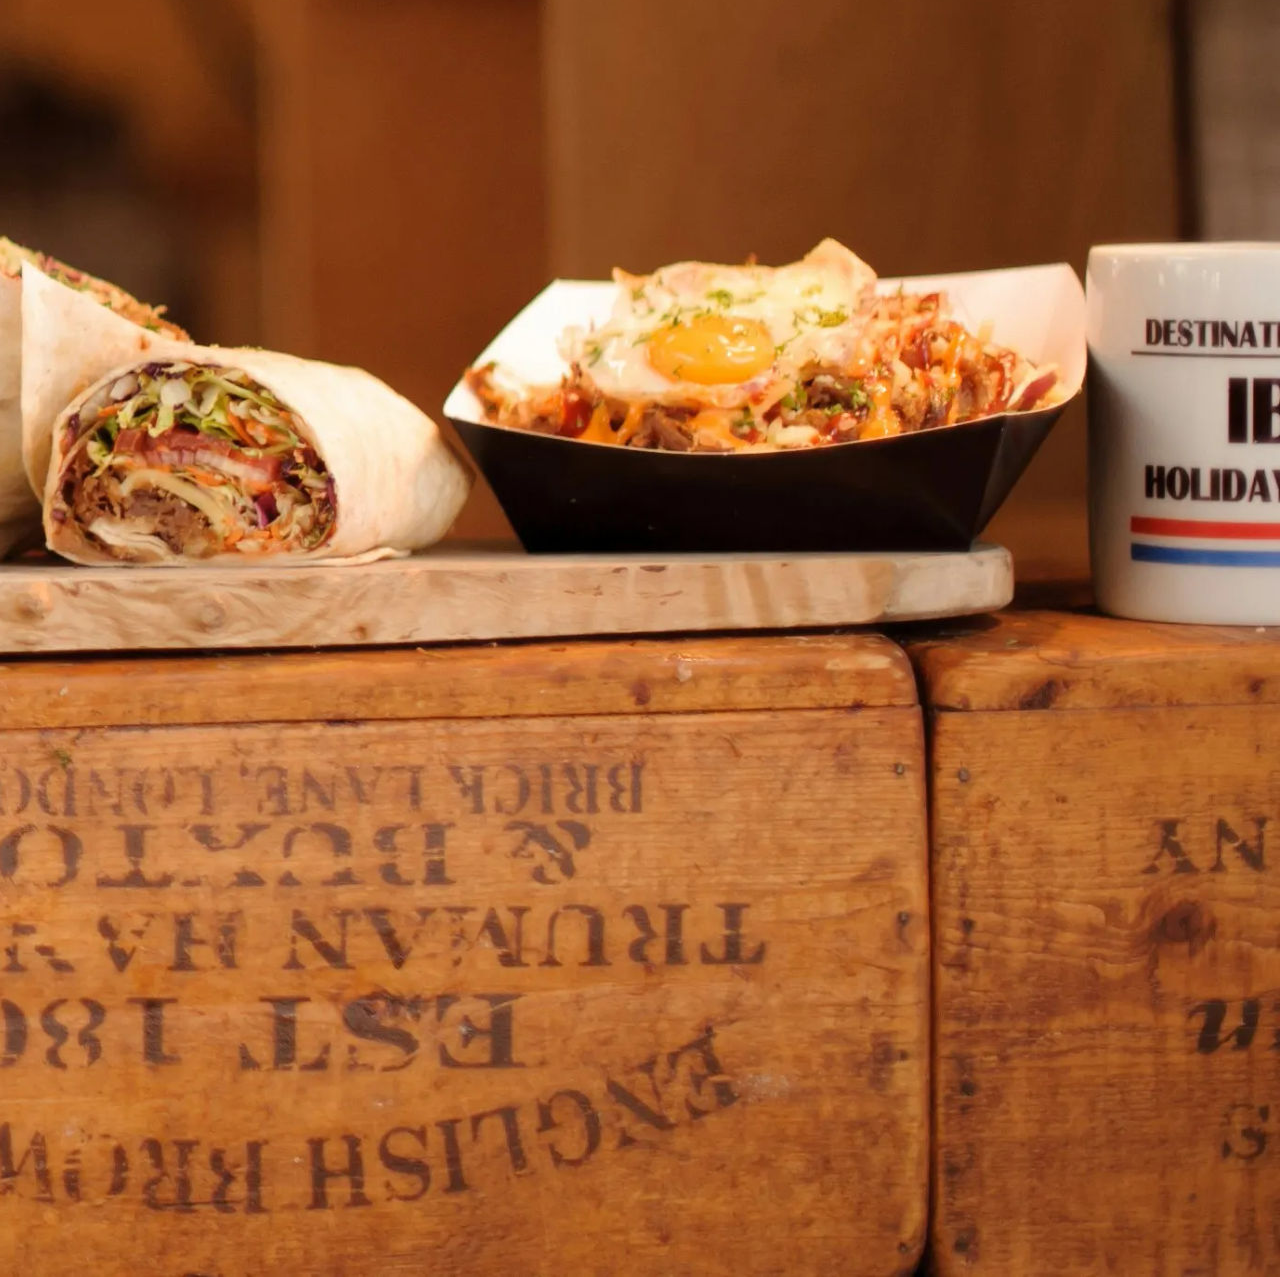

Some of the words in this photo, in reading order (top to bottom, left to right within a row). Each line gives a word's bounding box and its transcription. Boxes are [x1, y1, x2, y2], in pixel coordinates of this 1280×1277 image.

[448, 761, 644, 815] BRICK
[505, 820, 592, 885] &
[281, 902, 767, 971] TRUMAN
[240, 992, 530, 1073] EST
[306, 1023, 742, 1211] ENGLISH
